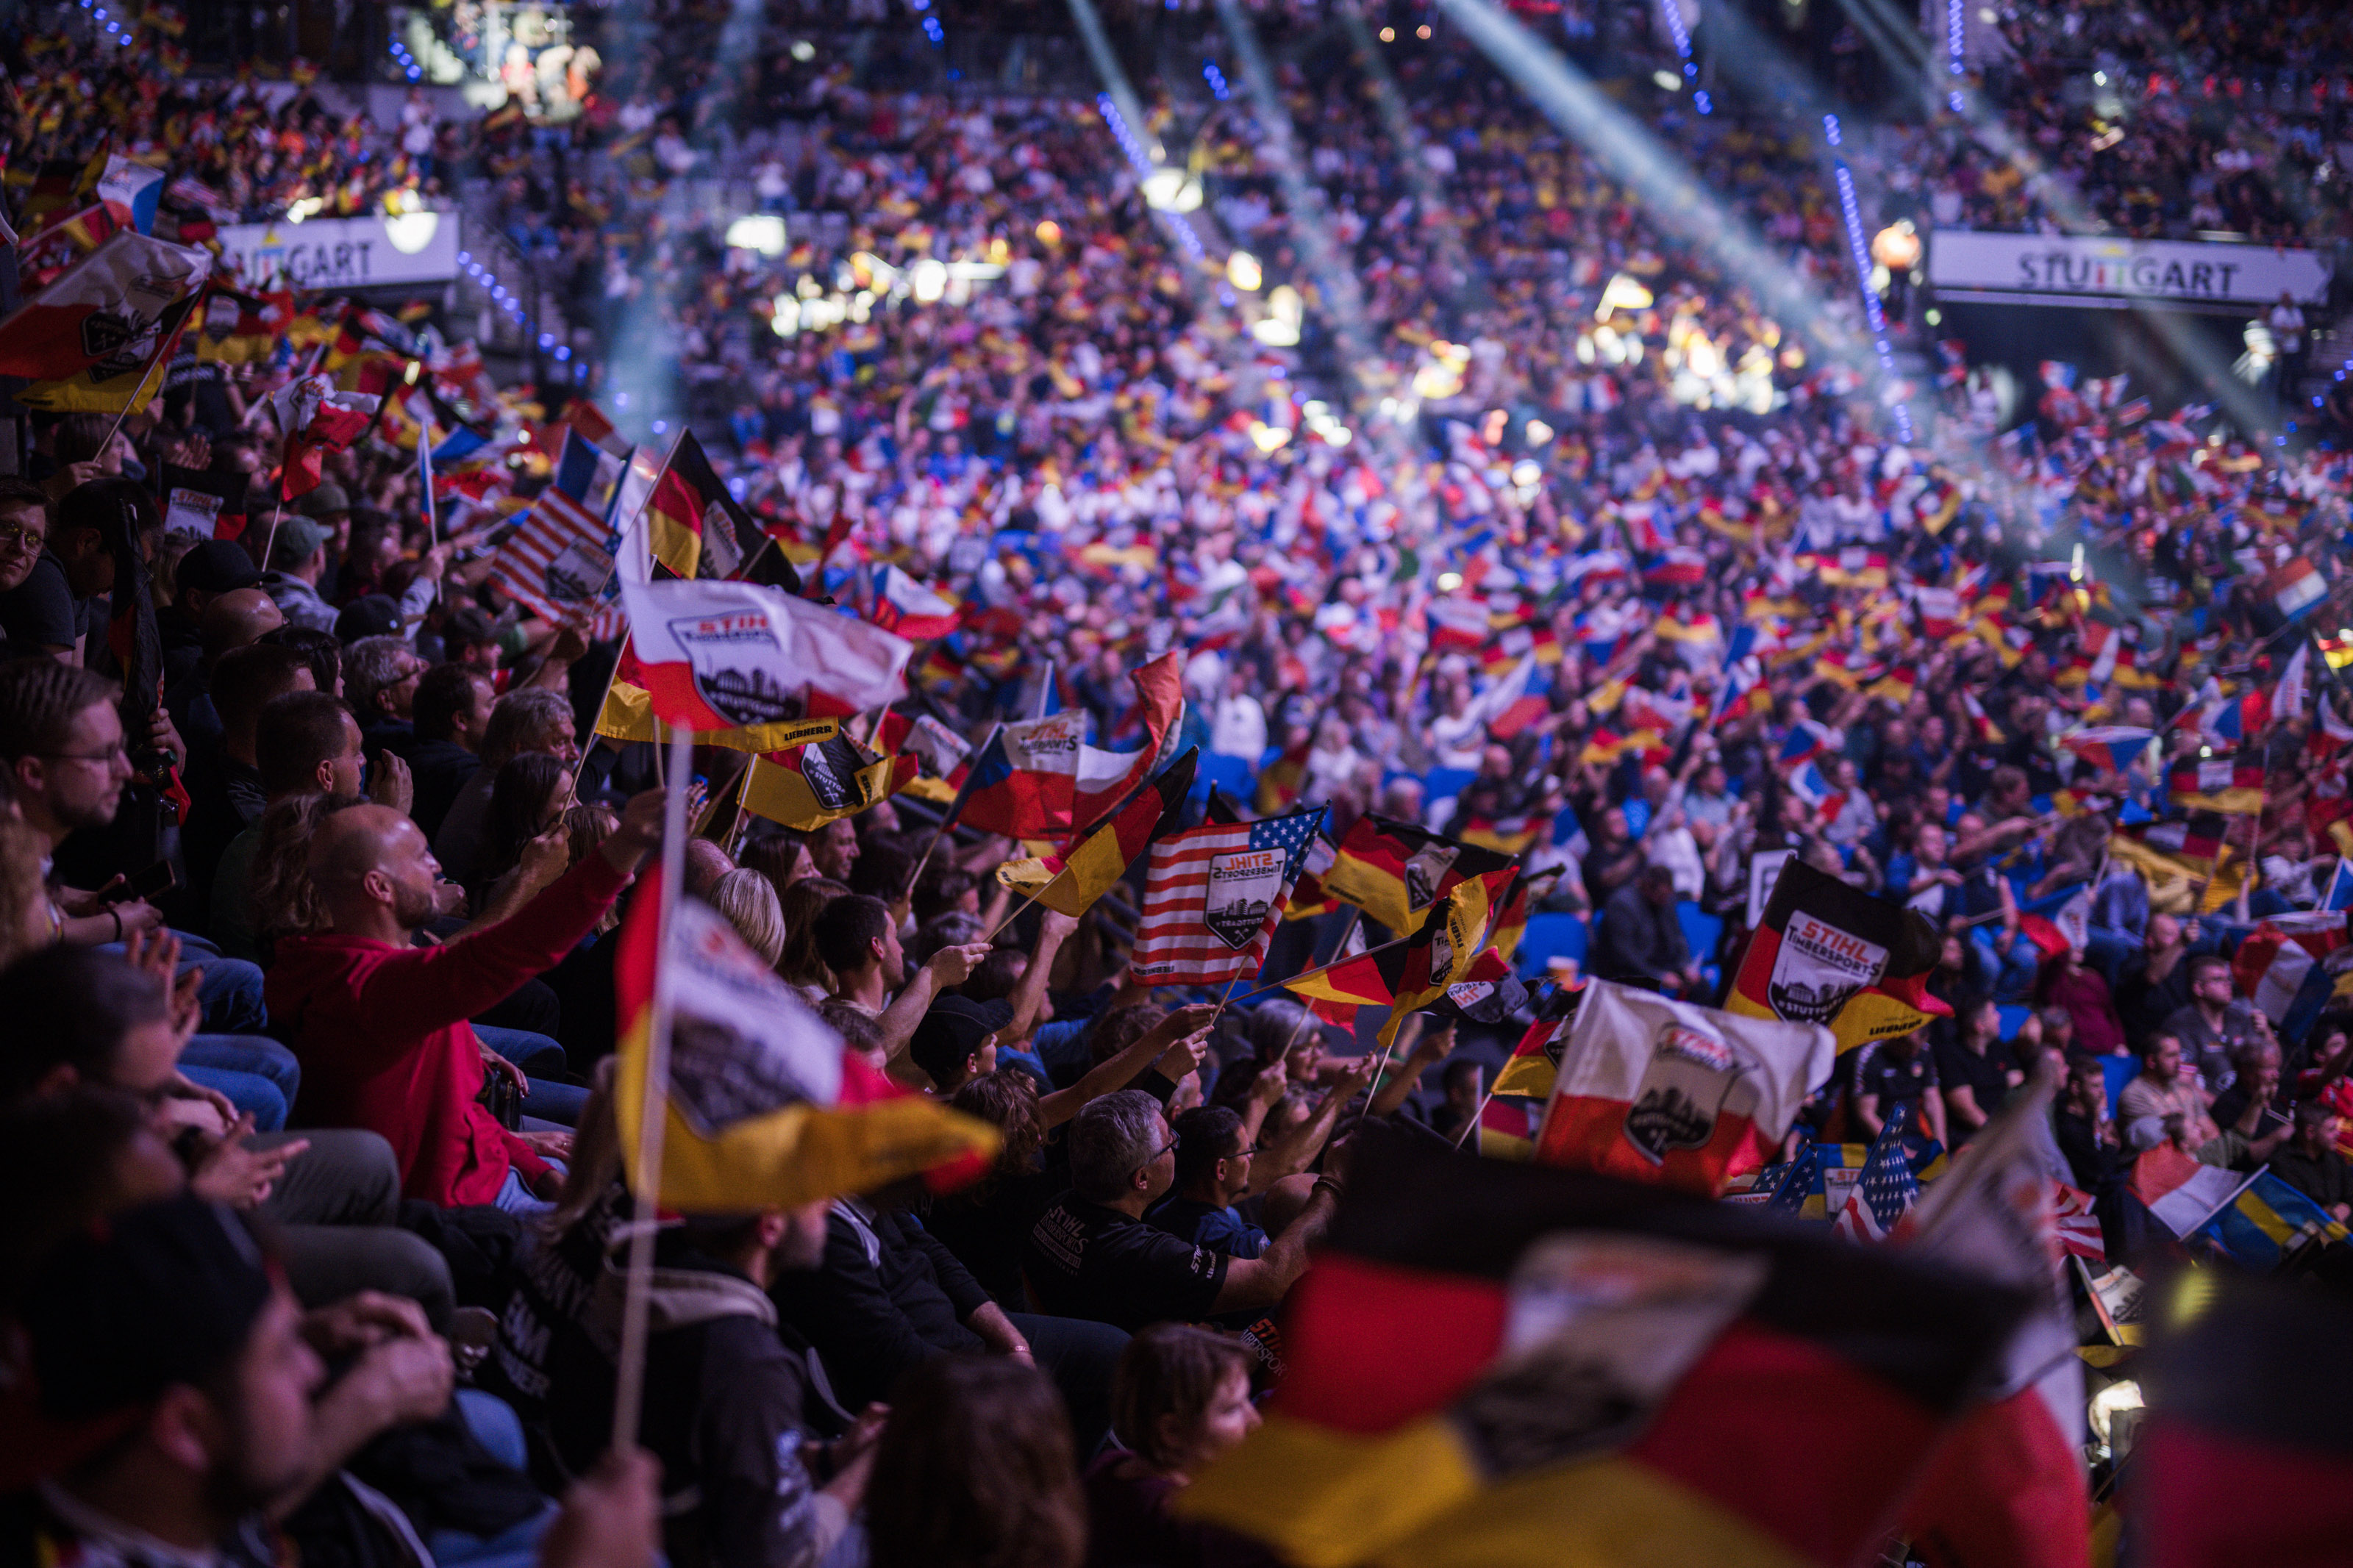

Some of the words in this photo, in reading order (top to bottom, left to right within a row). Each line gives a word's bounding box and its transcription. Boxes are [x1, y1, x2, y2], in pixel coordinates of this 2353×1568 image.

[237, 238, 374, 285] UTTGART
[2019, 251, 2240, 297] STUTTGART
[699, 615, 768, 632] STIH
[784, 725, 833, 742] LIEBHERR
[814, 771, 846, 793] STUTTGA
[1788, 925, 1882, 977] TIMBERSPORTS
[1801, 920, 1870, 964] STIHL
[1240, 1328, 1288, 1377] MBERSPOR
